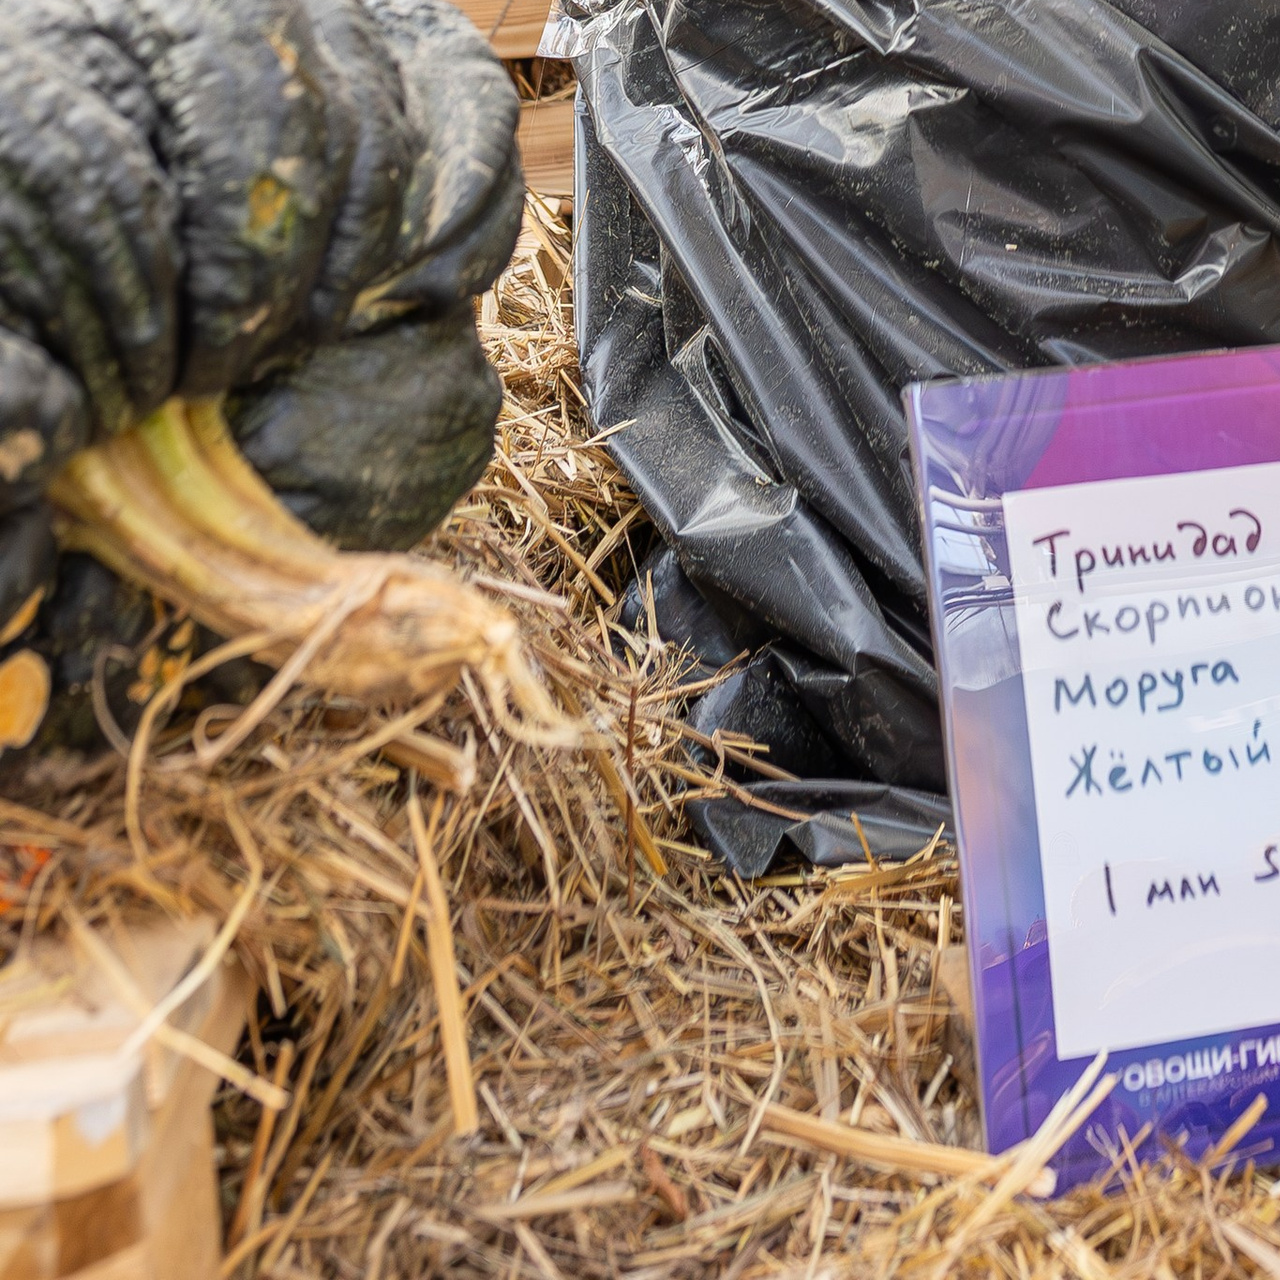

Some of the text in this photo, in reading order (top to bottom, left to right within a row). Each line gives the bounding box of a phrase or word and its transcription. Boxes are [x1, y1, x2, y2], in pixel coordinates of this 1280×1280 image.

[1032, 508, 1262, 594] Тринидад
[1054, 659, 1240, 714] Моруга
[1065, 718, 1271, 799] Жёлтый
[1146, 871, 1221, 908] млн
